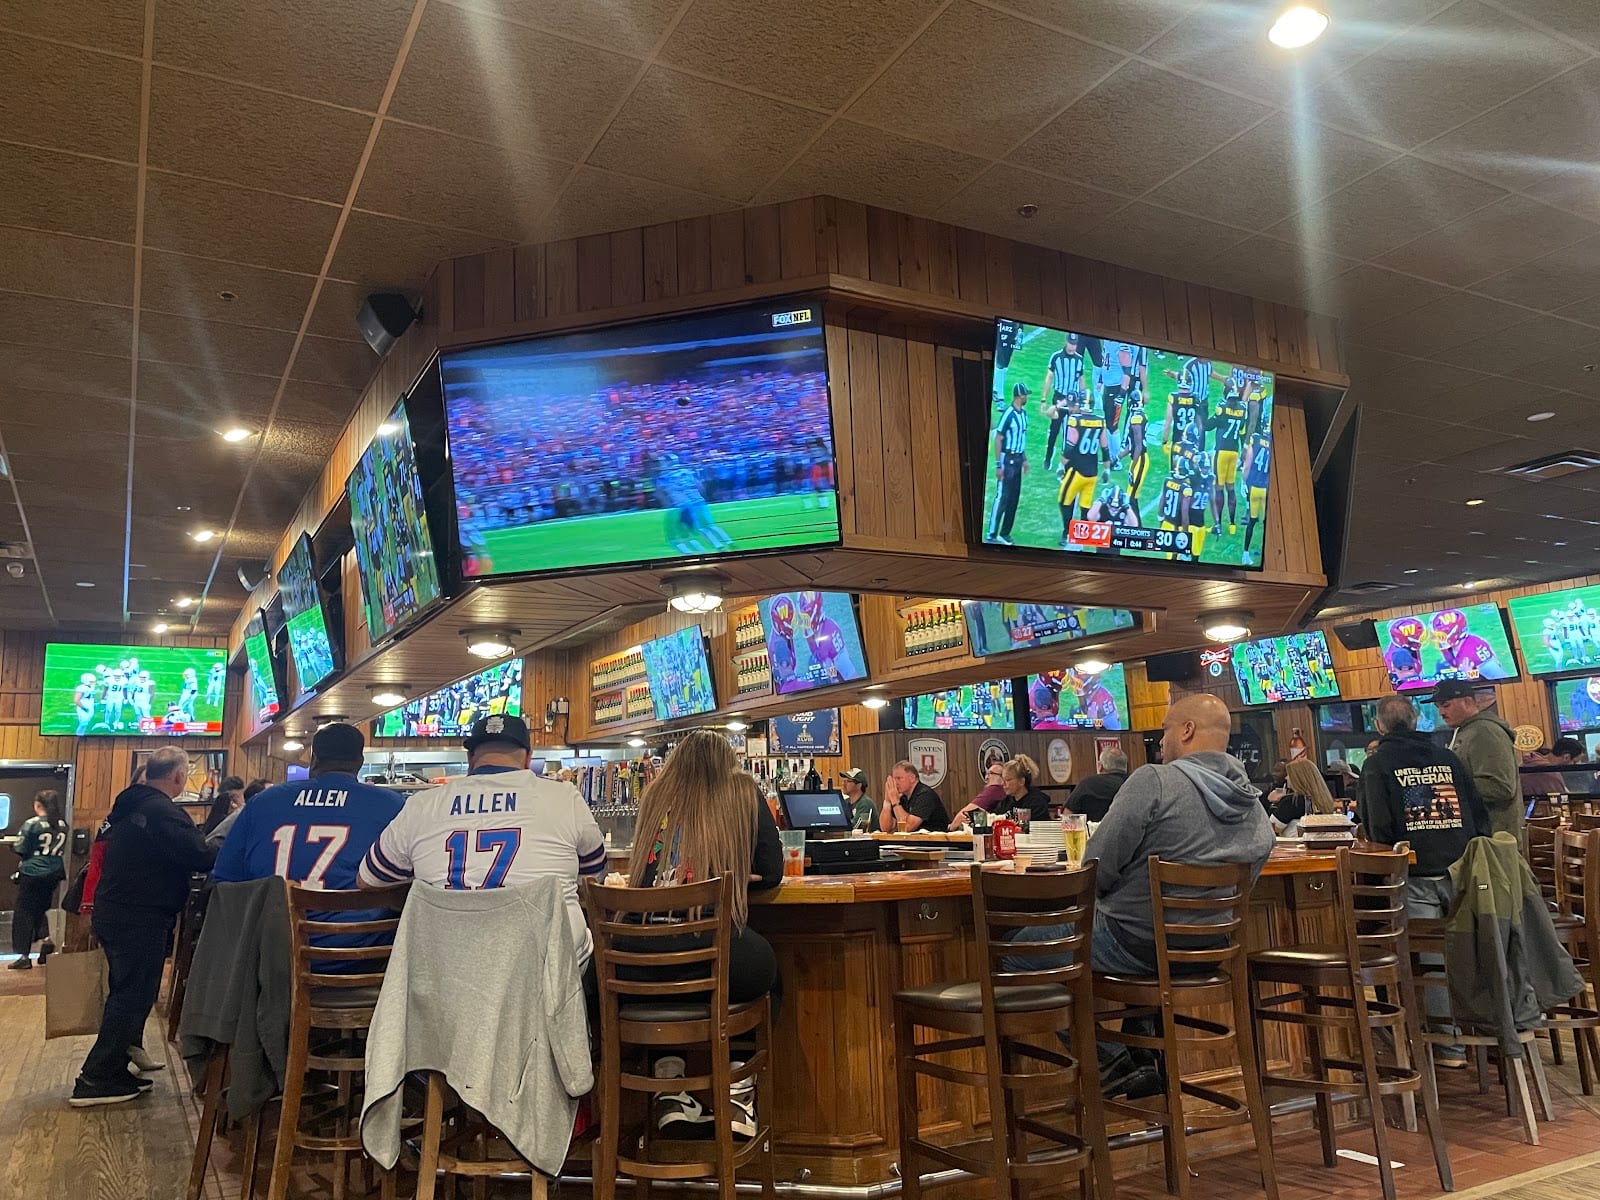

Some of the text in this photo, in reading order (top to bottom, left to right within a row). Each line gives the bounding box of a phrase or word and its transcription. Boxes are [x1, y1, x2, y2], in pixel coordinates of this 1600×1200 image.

[773, 311, 809, 326] FOX NFL
[1177, 408, 1195, 430] 33
[1223, 419, 1241, 440] 71
[1080, 428, 1101, 455] 66
[1164, 489, 1179, 517] 31
[1091, 524, 1109, 540] 27
[1131, 529, 1151, 537] SPORTS
[1156, 531, 1173, 546] 30
[1022, 626, 1032, 637] 27
[1056, 619, 1067, 629] 30
[913, 745, 943, 753] SPATEN
[1394, 765, 1452, 777] UNITED STATES
[1397, 773, 1454, 787] VETERAN
[294, 789, 348, 807] ALLEN
[450, 792, 517, 816] ALLEN
[36, 832, 67, 856] 32
[272, 824, 351, 889] 17
[445, 827, 522, 890] 17
